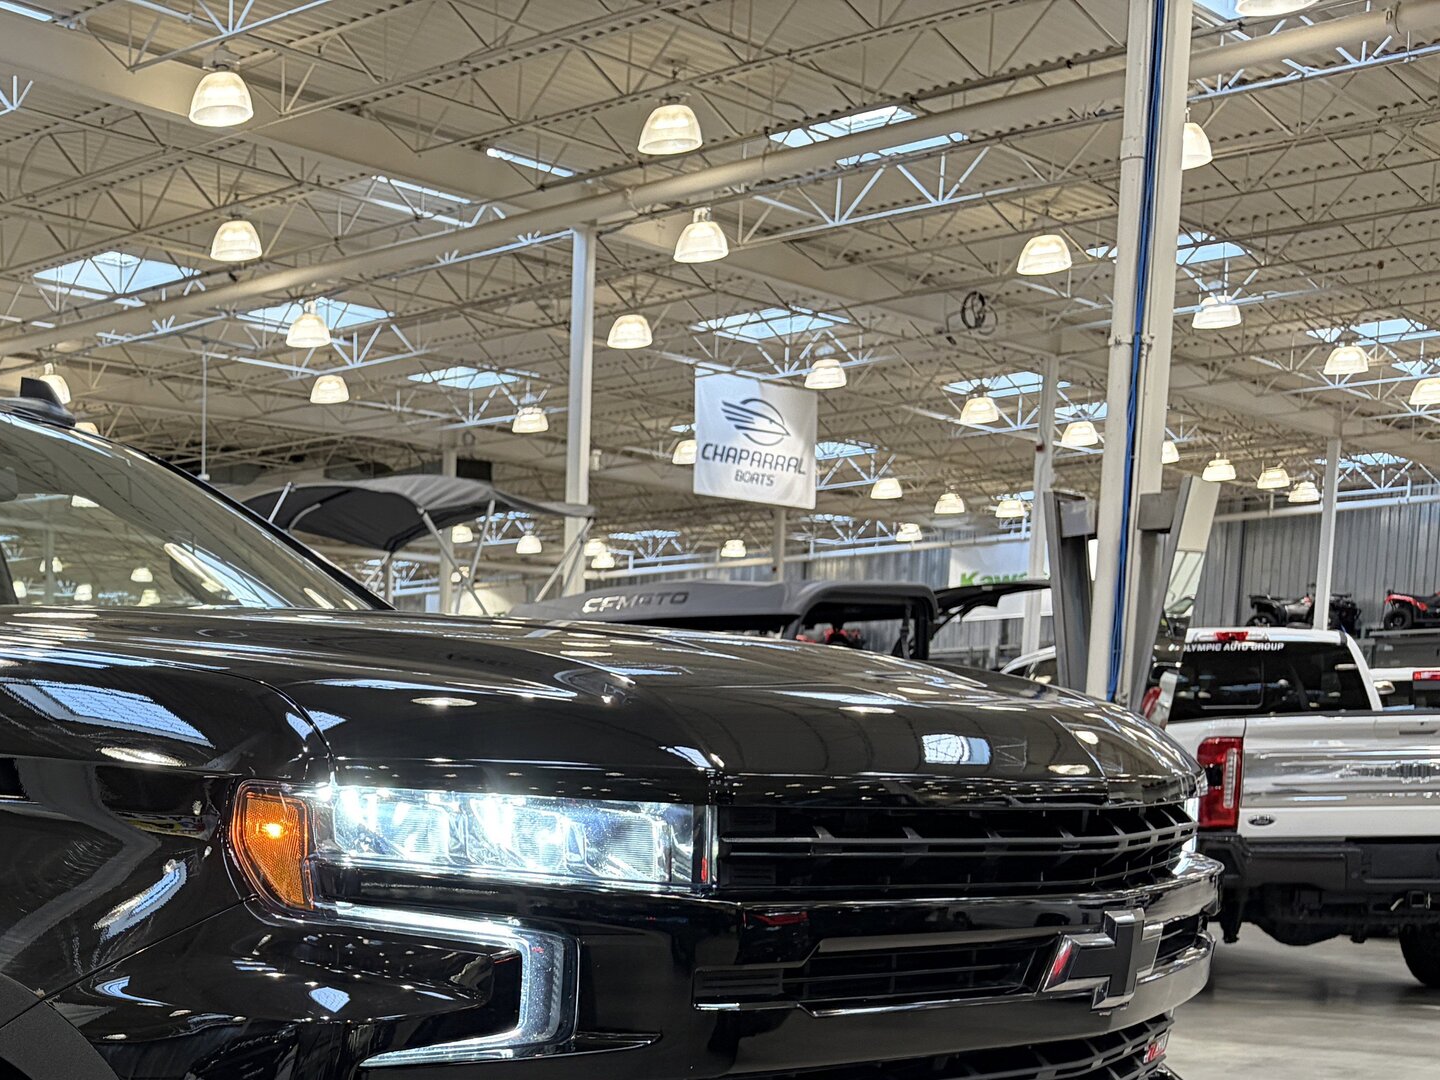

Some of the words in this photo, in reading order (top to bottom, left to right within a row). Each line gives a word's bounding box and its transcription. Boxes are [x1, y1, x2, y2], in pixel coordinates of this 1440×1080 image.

[701, 442, 806, 475] CHAPARRAL
[734, 469, 775, 486] BOATS
[582, 591, 689, 613] CFMOTO
[1223, 643, 1249, 652] AUTO
[1250, 643, 1285, 652] GROUP
